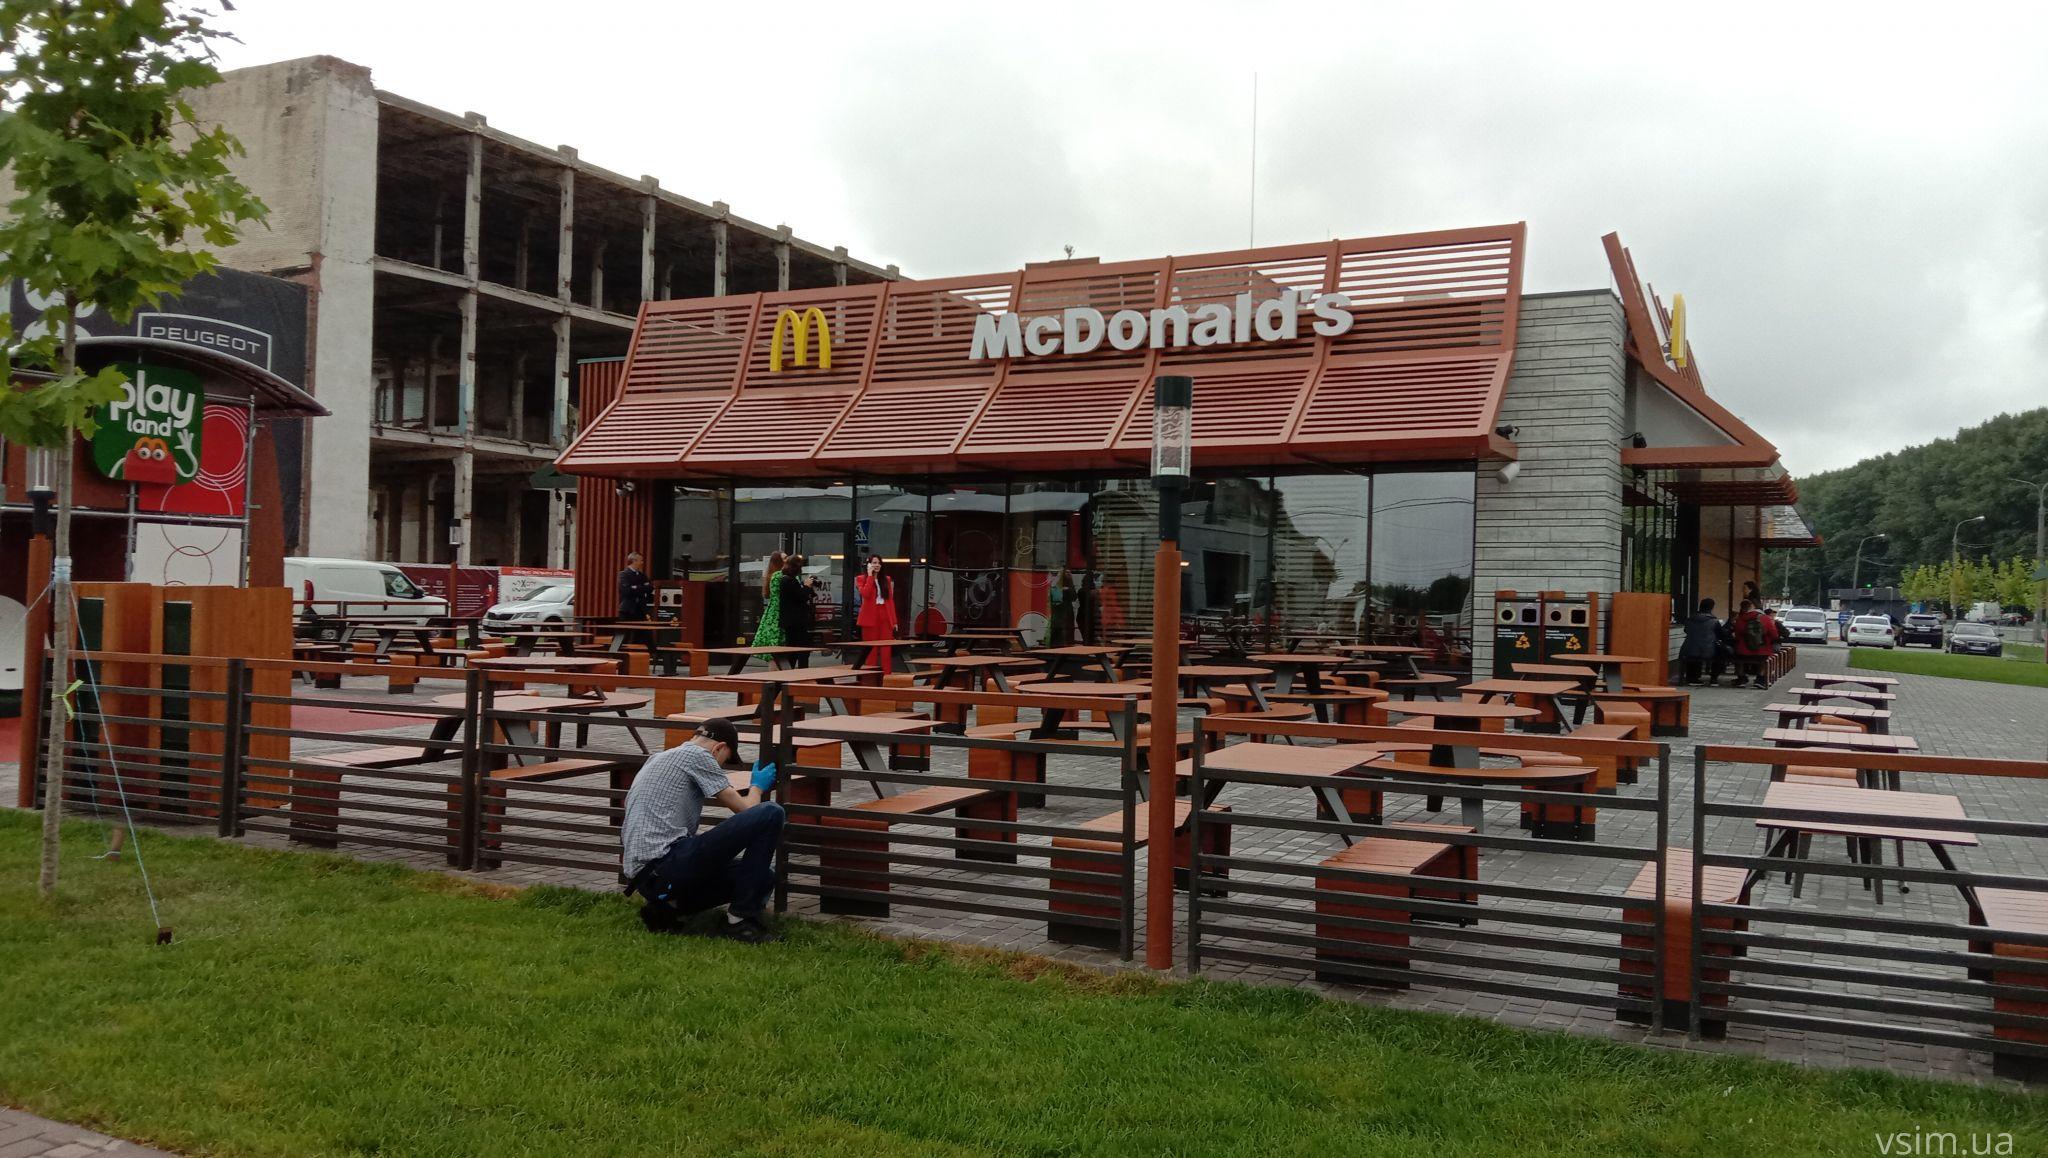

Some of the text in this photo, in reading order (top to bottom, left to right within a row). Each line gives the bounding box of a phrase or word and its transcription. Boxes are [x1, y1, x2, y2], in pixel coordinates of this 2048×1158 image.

[151, 326, 261, 354] PEUGEOT
[968, 289, 1355, 361] McDonald's
[110, 369, 197, 429] play
[126, 412, 173, 437] land
